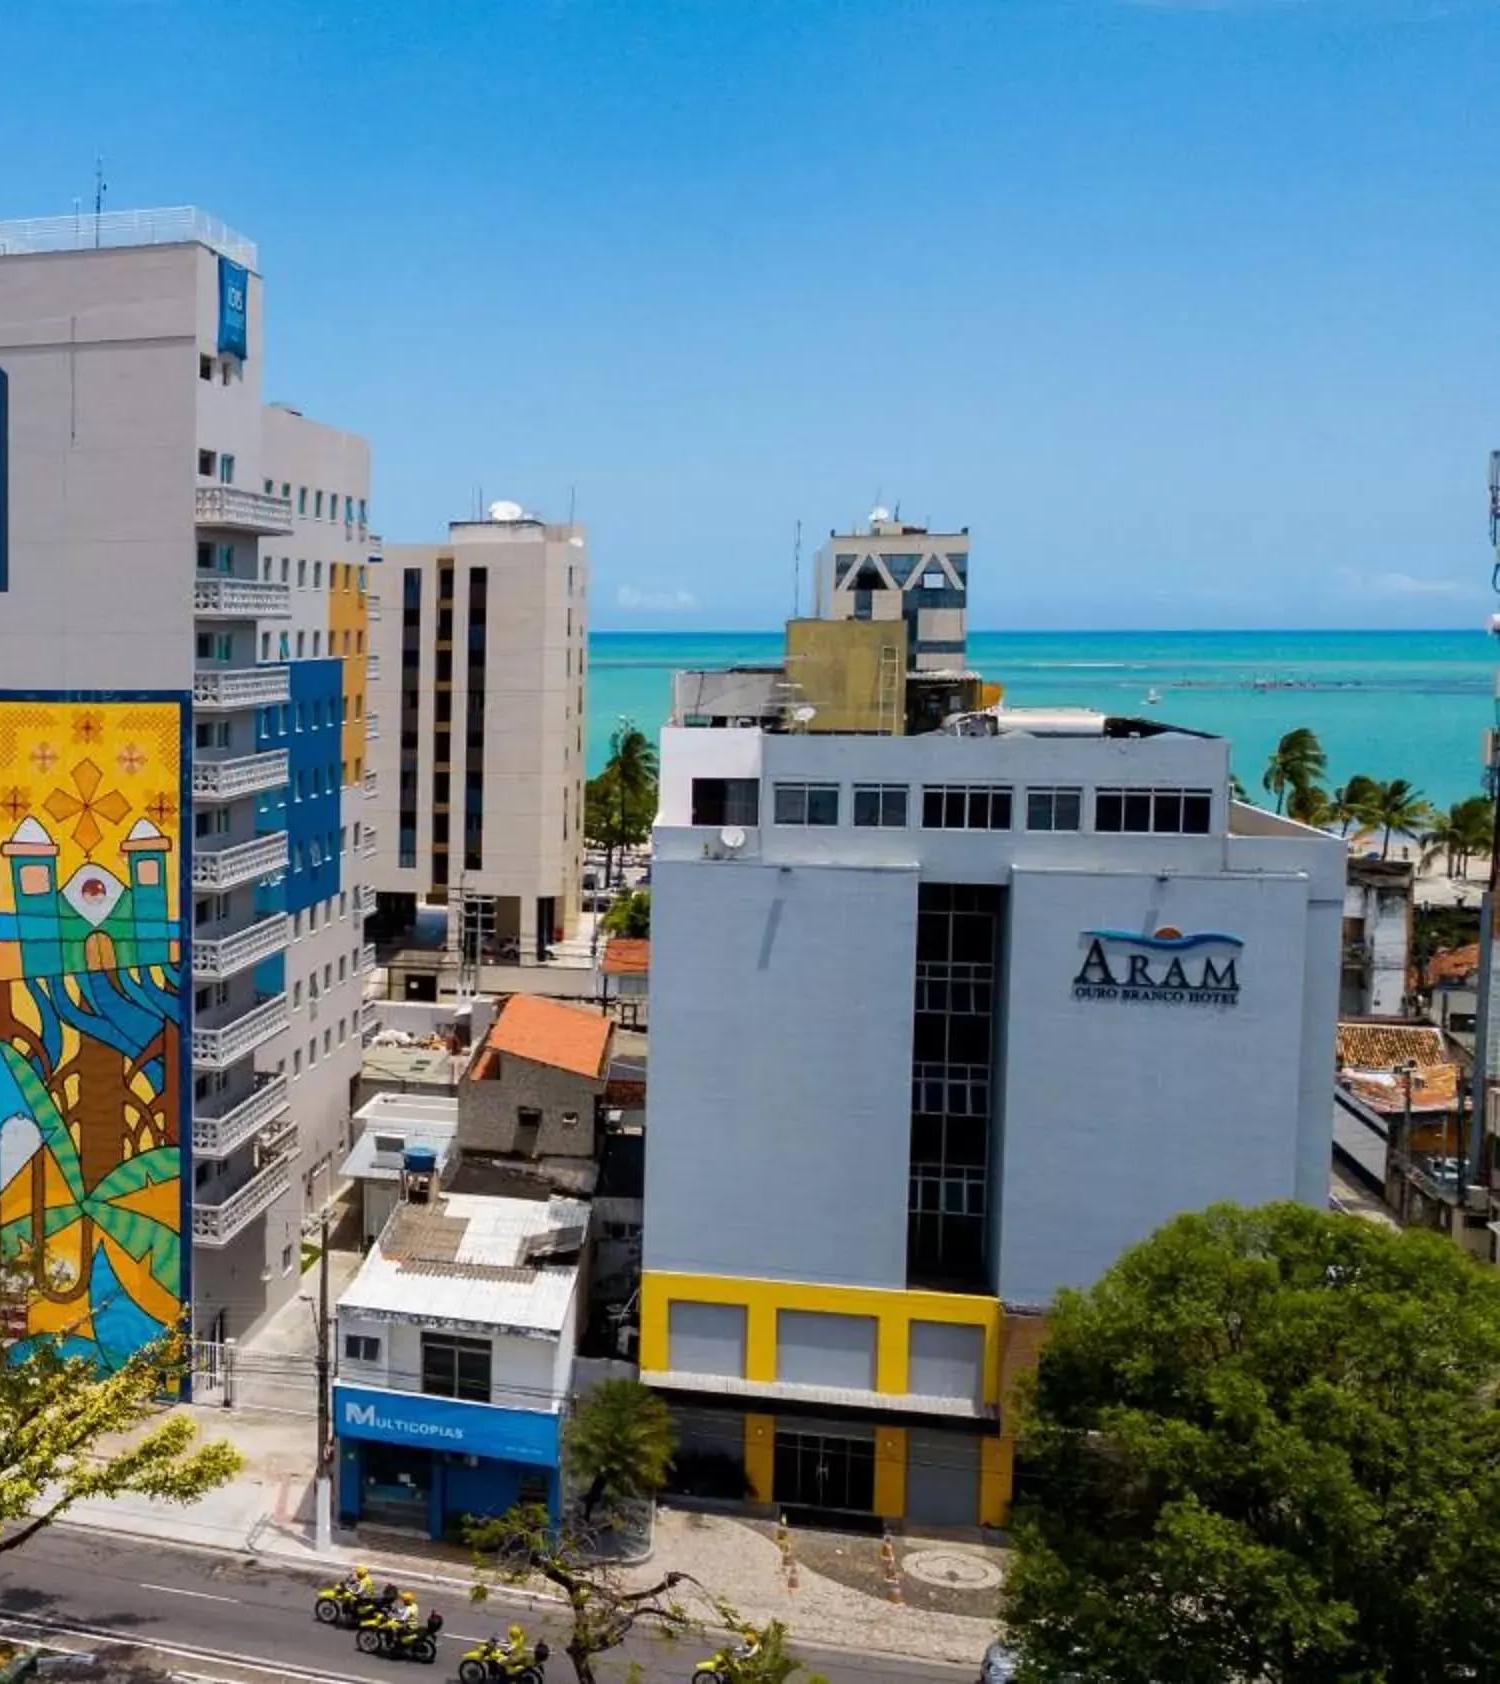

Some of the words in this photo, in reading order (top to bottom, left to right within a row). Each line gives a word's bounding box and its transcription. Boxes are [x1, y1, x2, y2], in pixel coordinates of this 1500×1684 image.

[1073, 938, 1239, 991] ARAM
[1075, 987, 1118, 1000] OURO
[1121, 989, 1185, 1002] BRANCO
[1189, 991, 1239, 1005] HOTEL
